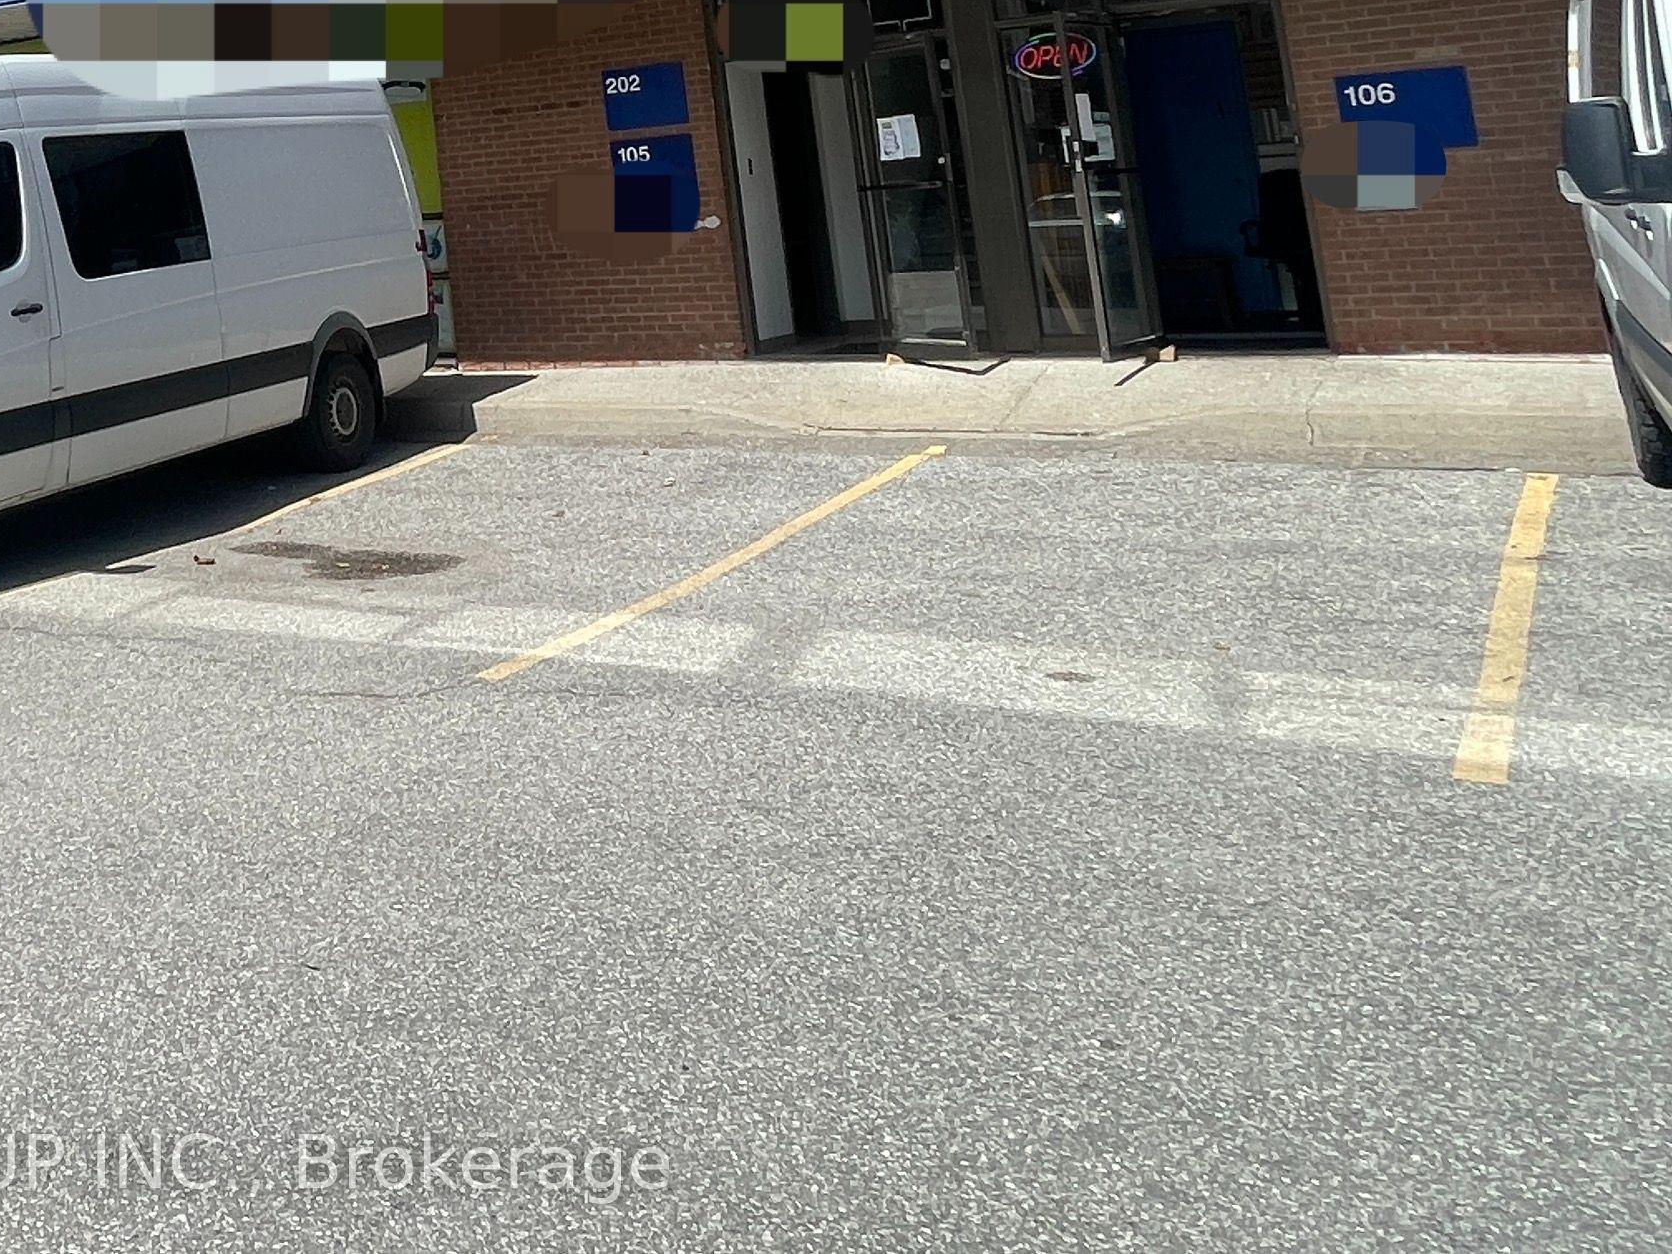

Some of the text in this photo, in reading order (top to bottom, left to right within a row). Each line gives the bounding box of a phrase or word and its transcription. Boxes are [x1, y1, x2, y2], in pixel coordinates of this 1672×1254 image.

[1020, 43, 1088, 70] OPEN
[605, 74, 641, 94] 202
[1343, 82, 1396, 106] 106
[617, 145, 651, 163] 105
